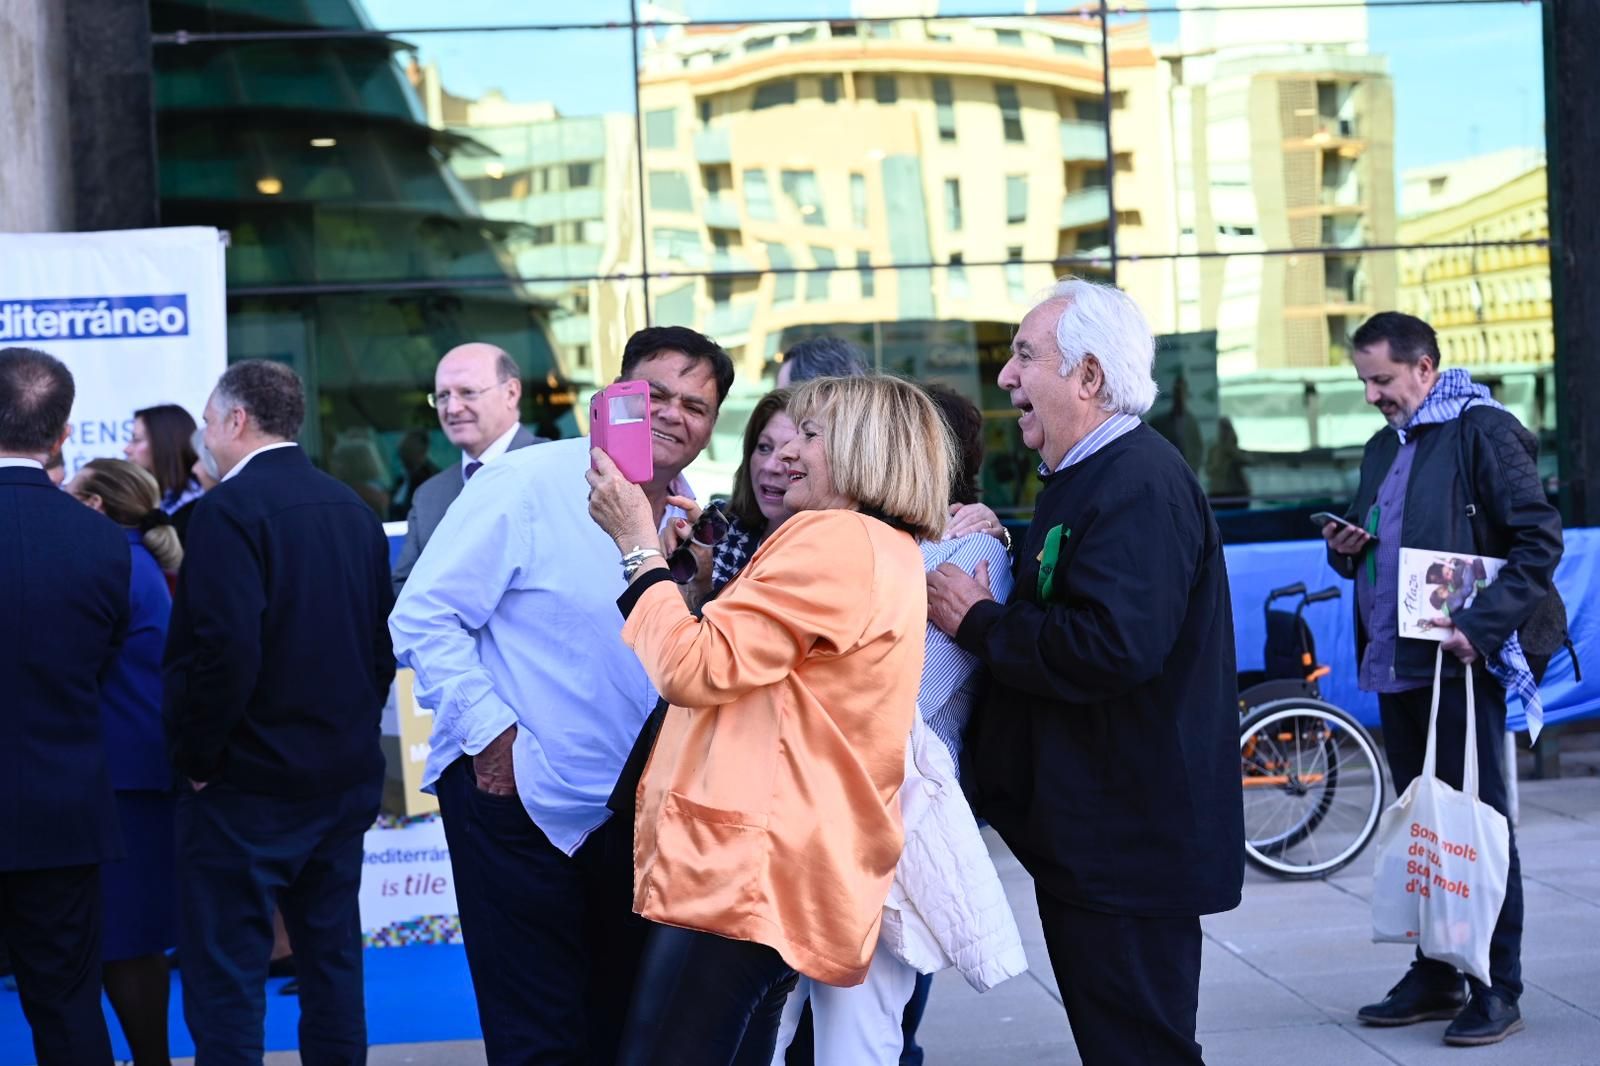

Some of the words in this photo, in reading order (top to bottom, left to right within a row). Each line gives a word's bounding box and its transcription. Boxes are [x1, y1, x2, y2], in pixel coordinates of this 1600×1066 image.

[1411, 824, 1438, 845] Som
[1409, 842, 1424, 856] de
[382, 879, 398, 896] is
[405, 873, 446, 895] tile
[1434, 874, 1469, 898] molt
